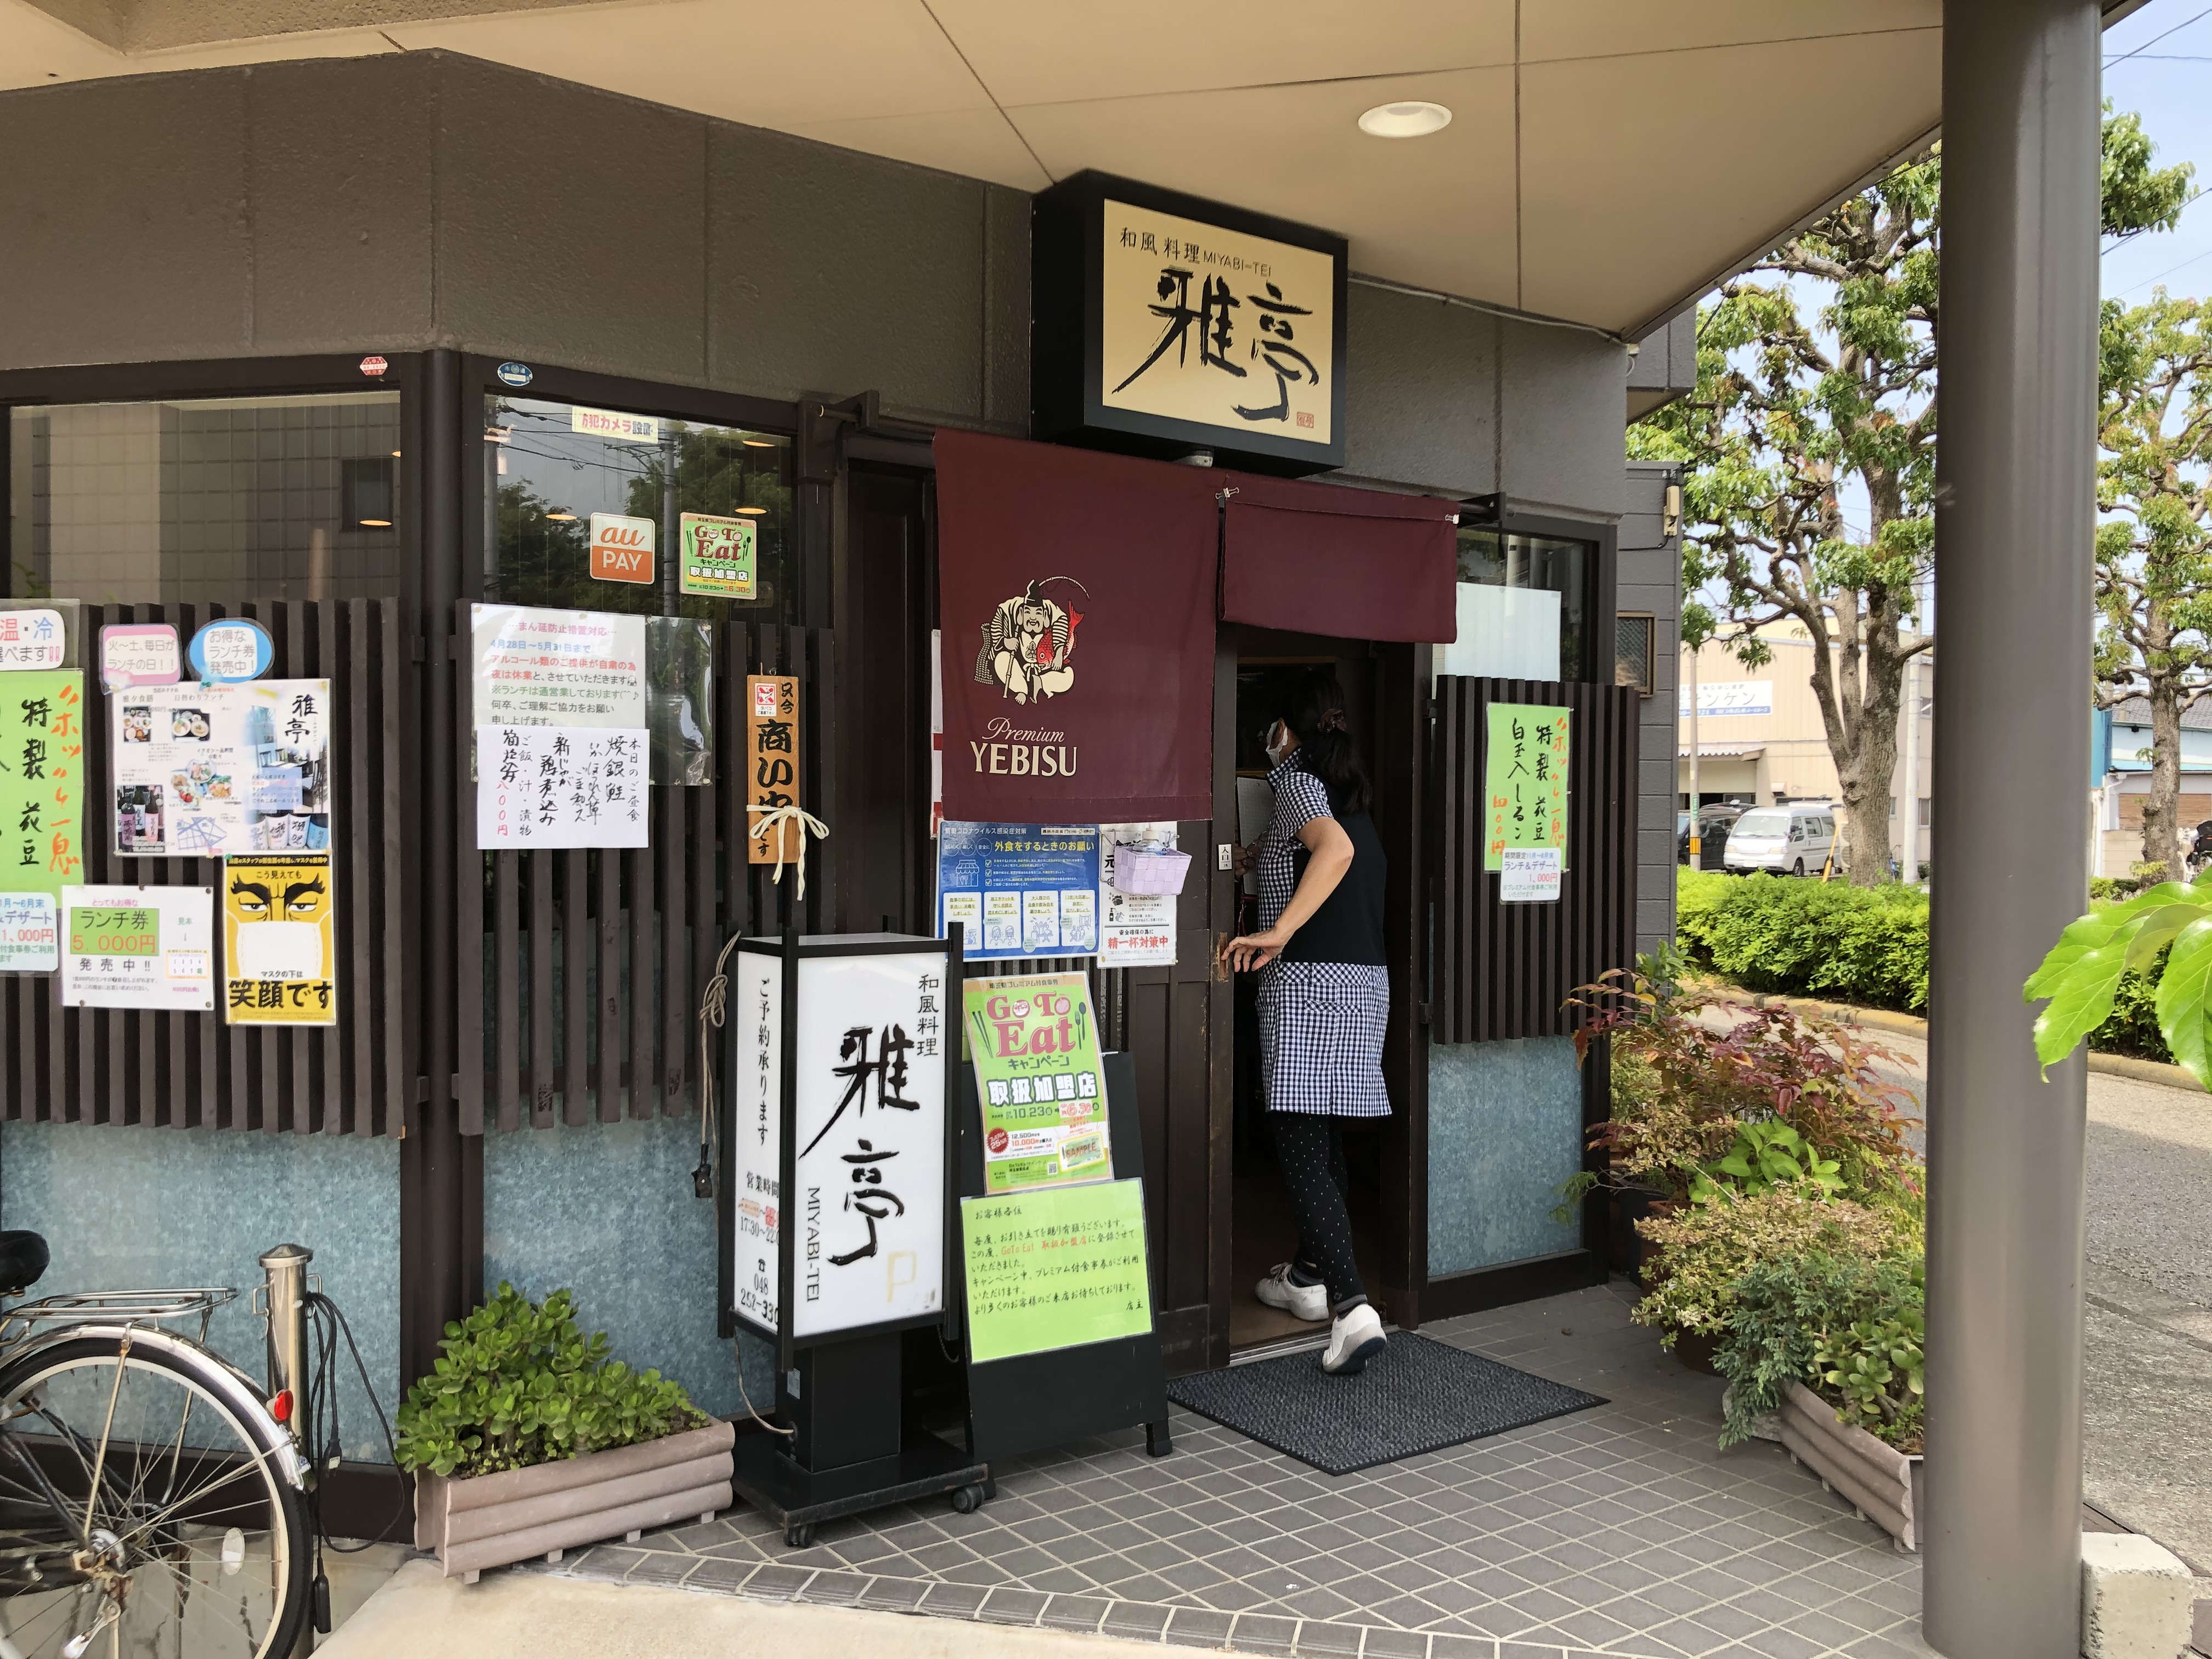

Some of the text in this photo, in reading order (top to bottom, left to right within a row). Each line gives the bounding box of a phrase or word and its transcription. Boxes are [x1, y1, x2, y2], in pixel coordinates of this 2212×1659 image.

[1119, 227, 1271, 278] 和風料理 MIYABI-TEI
[1111, 265, 1319, 422] 雅亭
[600, 527, 646, 546] au
[695, 526, 743, 541] Go To
[695, 538, 742, 561] Eat
[603, 550, 642, 571] PAY
[700, 558, 736, 568] キャンペーン
[210, 629, 246, 643] お得な
[209, 645, 256, 658] ランチ券
[491, 654, 637, 672] アルコール類のご提供が自粛の為
[491, 699, 614, 714] 何卒、ご理解ご協力をお願い
[780, 682, 794, 715] 只今
[285, 694, 319, 744] 雅亭
[492, 715, 554, 727] 申し上げます。
[981, 717, 1065, 743] Premium
[969, 741, 1077, 777] YEBISU
[627, 738, 641, 822] 本日のご昼食
[995, 841, 1094, 853] 外食をするときのお願い
[1222, 847, 1229, 860] 入口
[256, 870, 302, 879] こう見えても
[92, 899, 139, 907] とってもお得な
[81, 910, 149, 930] ランチ券
[178, 917, 193, 926] 見本
[1108, 935, 1169, 950] 精一杯対策中
[261, 970, 303, 978] マスクの下は
[229, 979, 332, 1009] 笑顔です
[986, 990, 1071, 1020] Go To
[916, 973, 939, 1058] 和風料理
[992, 1017, 1076, 1058] Eat
[757, 978, 770, 1147] ご予約承ります
[1008, 1054, 1070, 1070] キャンペーン
[986, 1071, 1097, 1107] 取扱加盟店
[797, 1023, 921, 1266] 雅亭
[1065, 1141, 1097, 1159] SAMPLE
[746, 1170, 780, 1199] 営業時間
[975, 1206, 1022, 1220] お客様各位
[806, 1186, 821, 1303] MIYABI-TEI
[971, 1259, 1025, 1273] いただきました。
[754, 1273, 769, 1295] 048
[973, 1286, 1025, 1300] いただけます。
[1126, 1299, 1144, 1311] 店主
